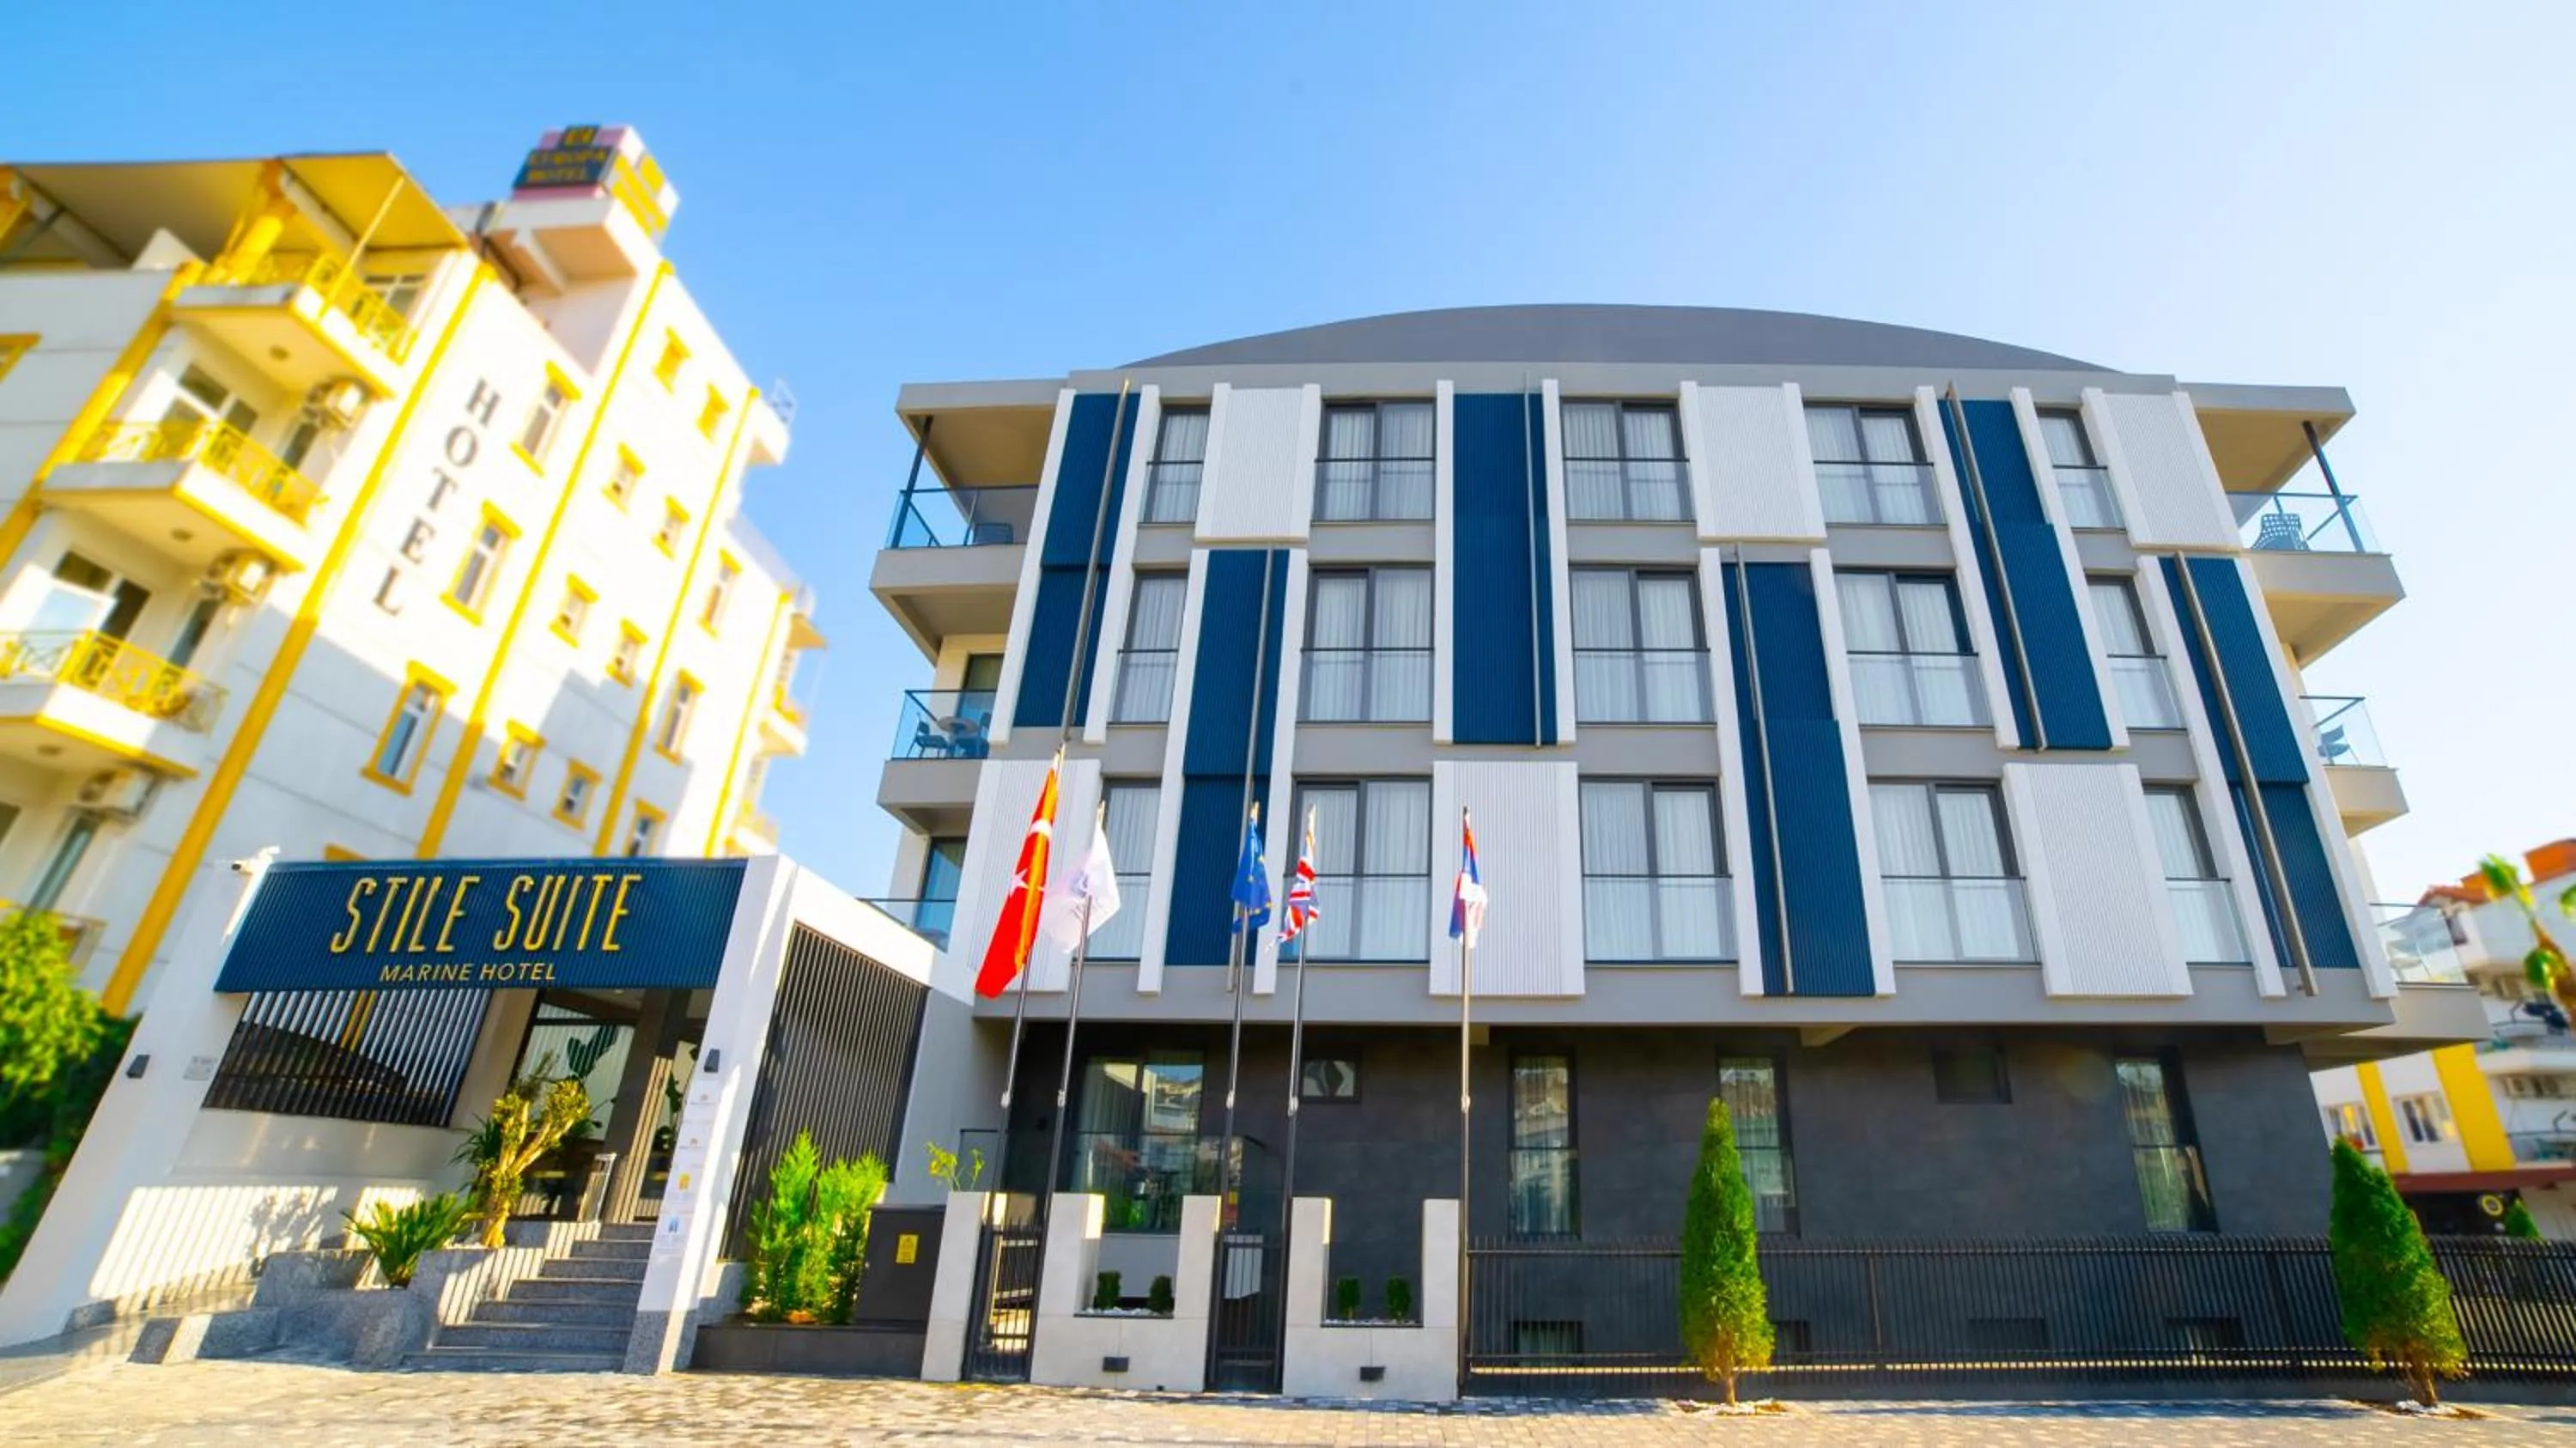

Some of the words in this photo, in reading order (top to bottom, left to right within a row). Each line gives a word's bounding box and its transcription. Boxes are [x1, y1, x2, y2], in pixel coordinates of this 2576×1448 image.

[373, 377, 501, 618] HOTEL
[330, 876, 480, 952] STILE
[493, 874, 642, 952] SUITE
[379, 963, 474, 983] MARINE
[479, 963, 556, 980] HOTEL
